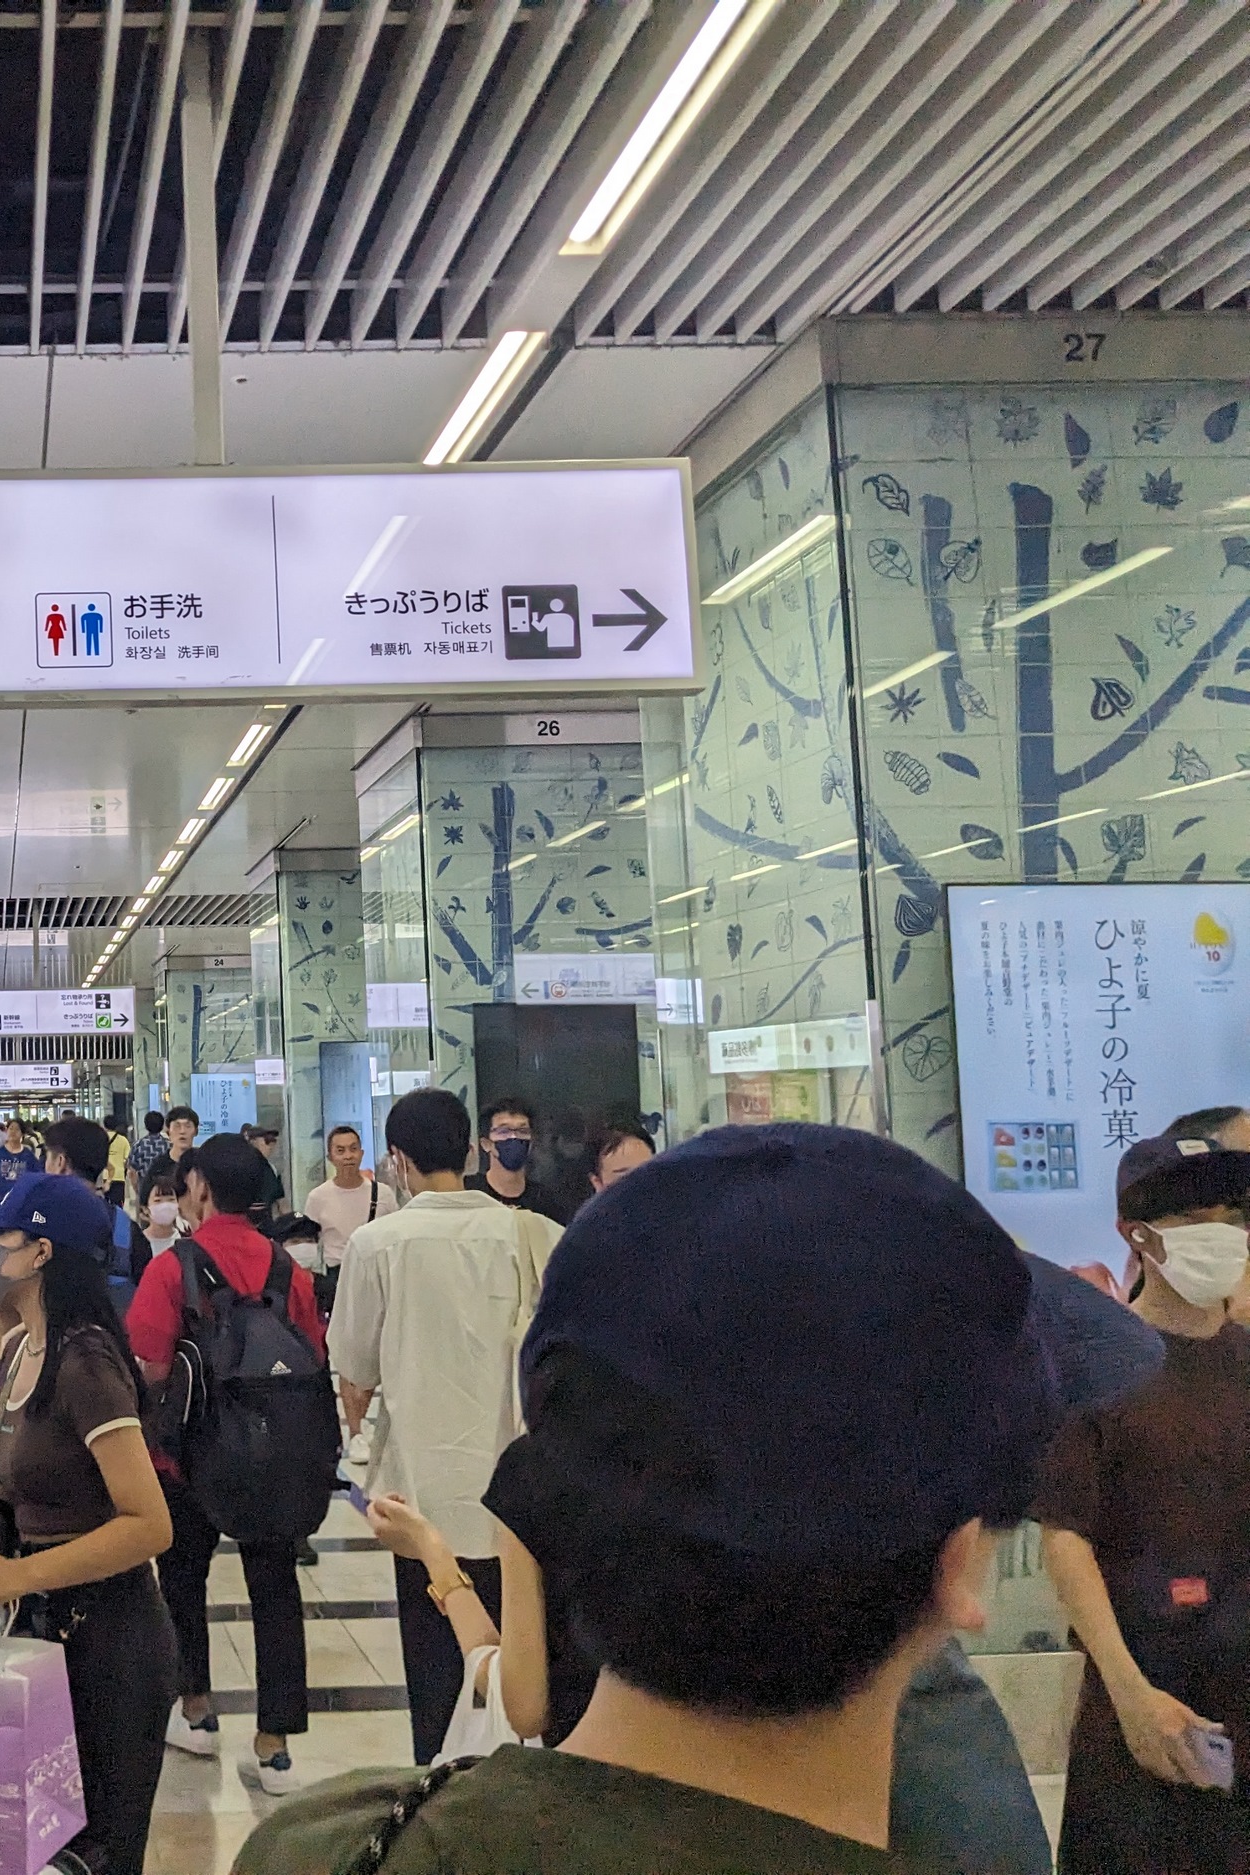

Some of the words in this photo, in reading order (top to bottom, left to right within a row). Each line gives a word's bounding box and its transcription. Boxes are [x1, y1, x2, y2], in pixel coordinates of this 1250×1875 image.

[1063, 332, 1106, 362] 27
[123, 593, 203, 619] お手洗
[344, 587, 490, 616] きっぷうりば
[124, 626, 171, 640] Toilets
[441, 620, 492, 635] Tickets
[125, 645, 167, 660] 화장실
[177, 645, 220, 660] 洗手间
[369, 641, 412, 656] 售票机
[423, 639, 494, 655] 자동매표기
[537, 720, 561, 737] 26
[214, 958, 225, 966] 24
[1130, 919, 1150, 1000] 涼やかに夏
[1206, 951, 1221, 962] 10
[1094, 919, 1140, 1150] ひよ子の冷菓
